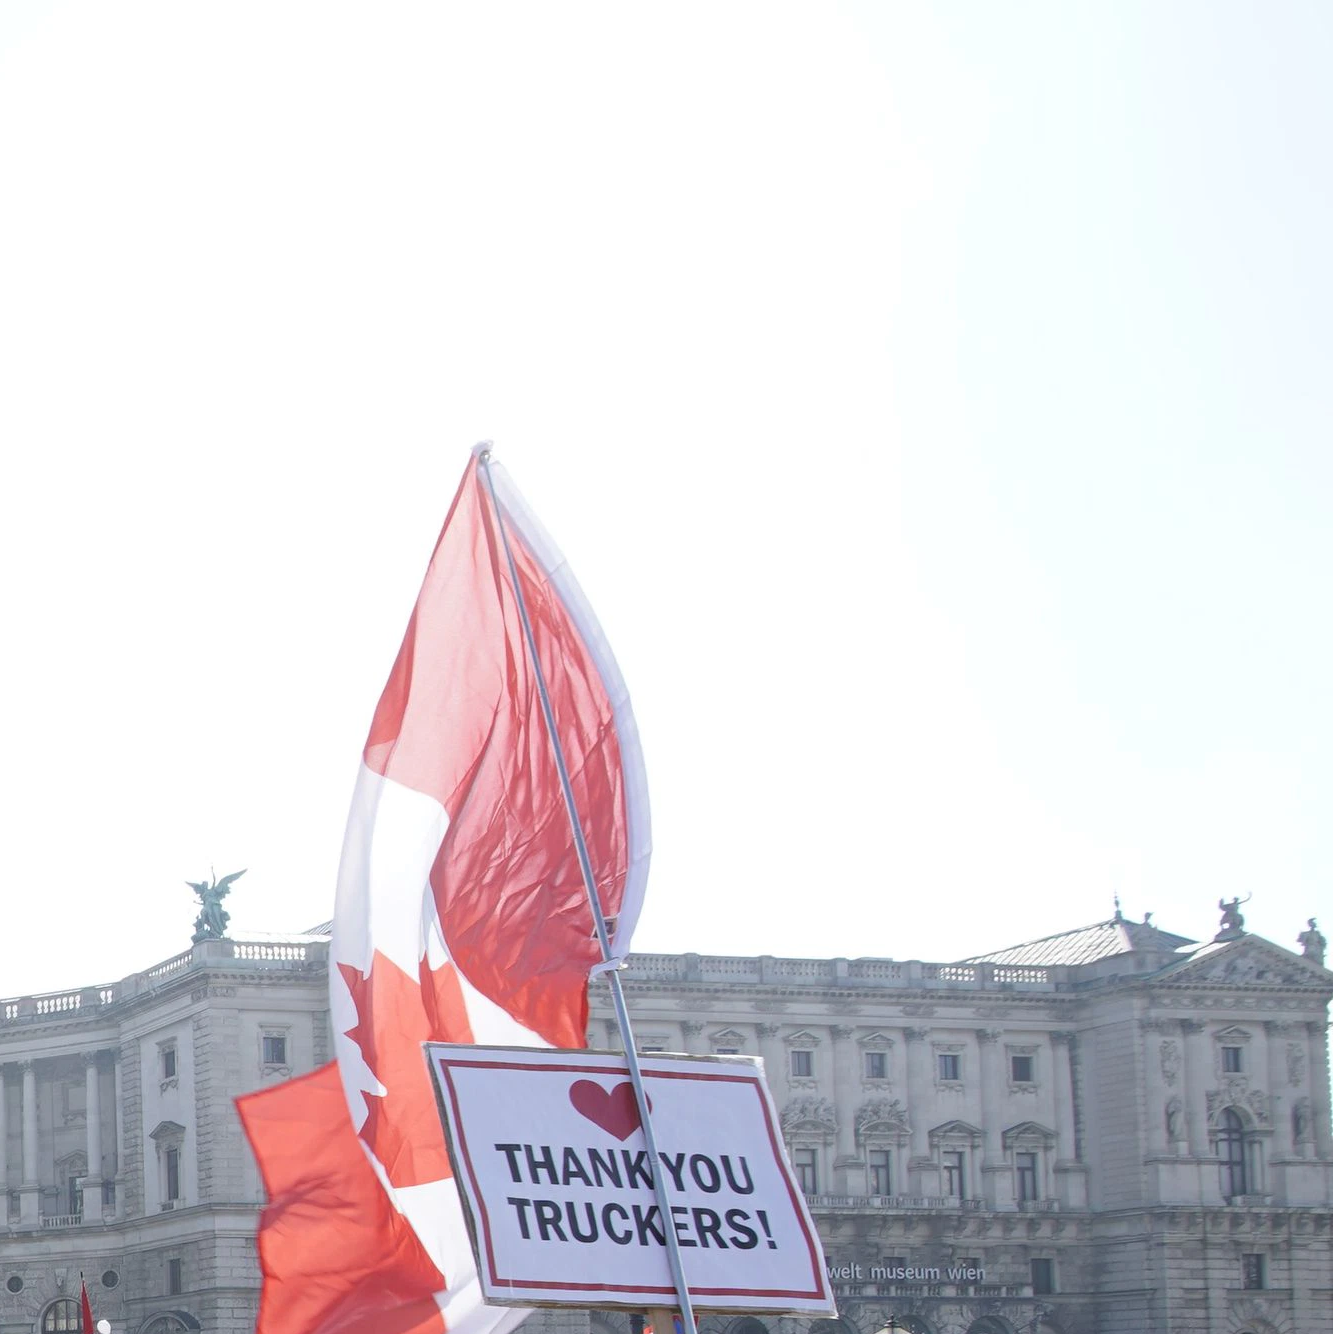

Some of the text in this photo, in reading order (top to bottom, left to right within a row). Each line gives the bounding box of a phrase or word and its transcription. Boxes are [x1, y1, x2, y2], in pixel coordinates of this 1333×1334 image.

[495, 1143, 754, 1195] THANK YOU
[507, 1196, 777, 1250] TRUCKERS!
[828, 1262, 986, 1280] welt museum wien
